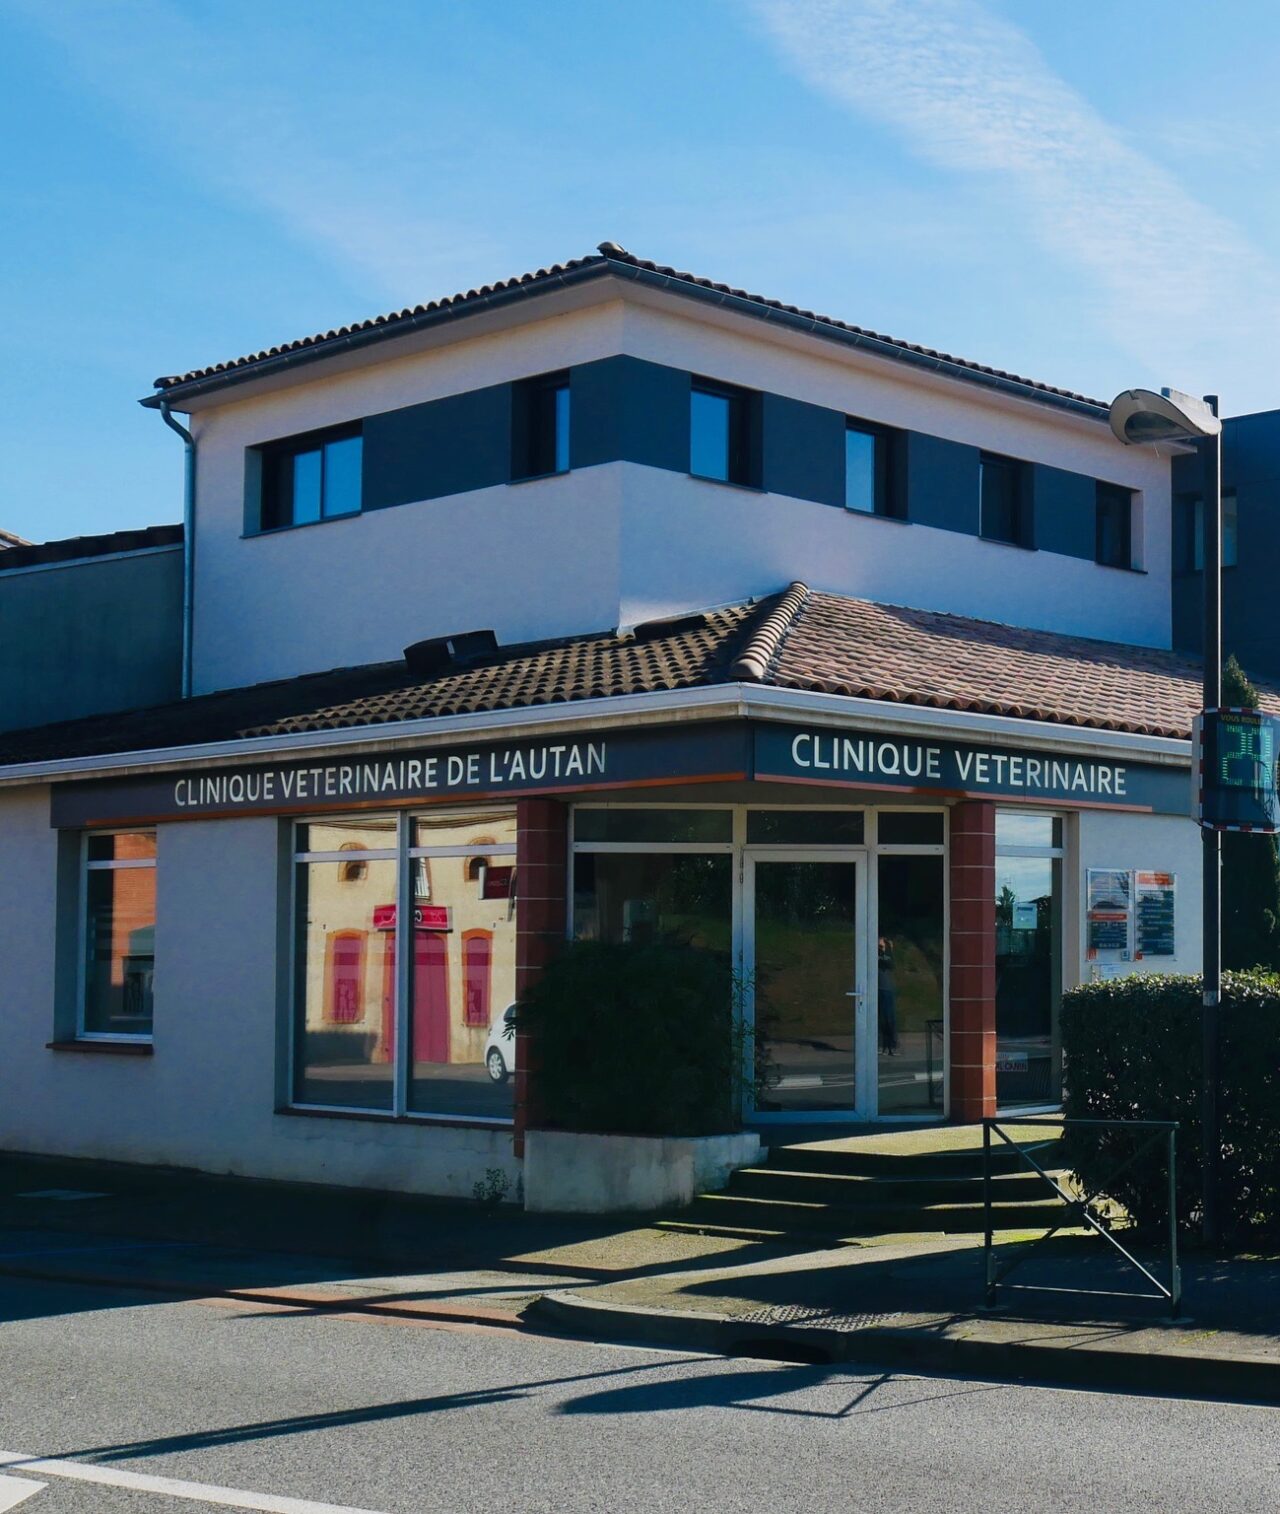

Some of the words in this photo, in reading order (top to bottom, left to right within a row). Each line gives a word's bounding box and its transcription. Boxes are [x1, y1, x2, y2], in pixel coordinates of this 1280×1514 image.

[174, 772, 274, 806] CLINIQUE
[280, 757, 438, 799] VETERINAIRE
[447, 754, 480, 786] DE
[490, 742, 606, 783] L'AUTAN
[791, 733, 942, 779] CLINIQUE
[955, 750, 1127, 796] VETERINAIRE
